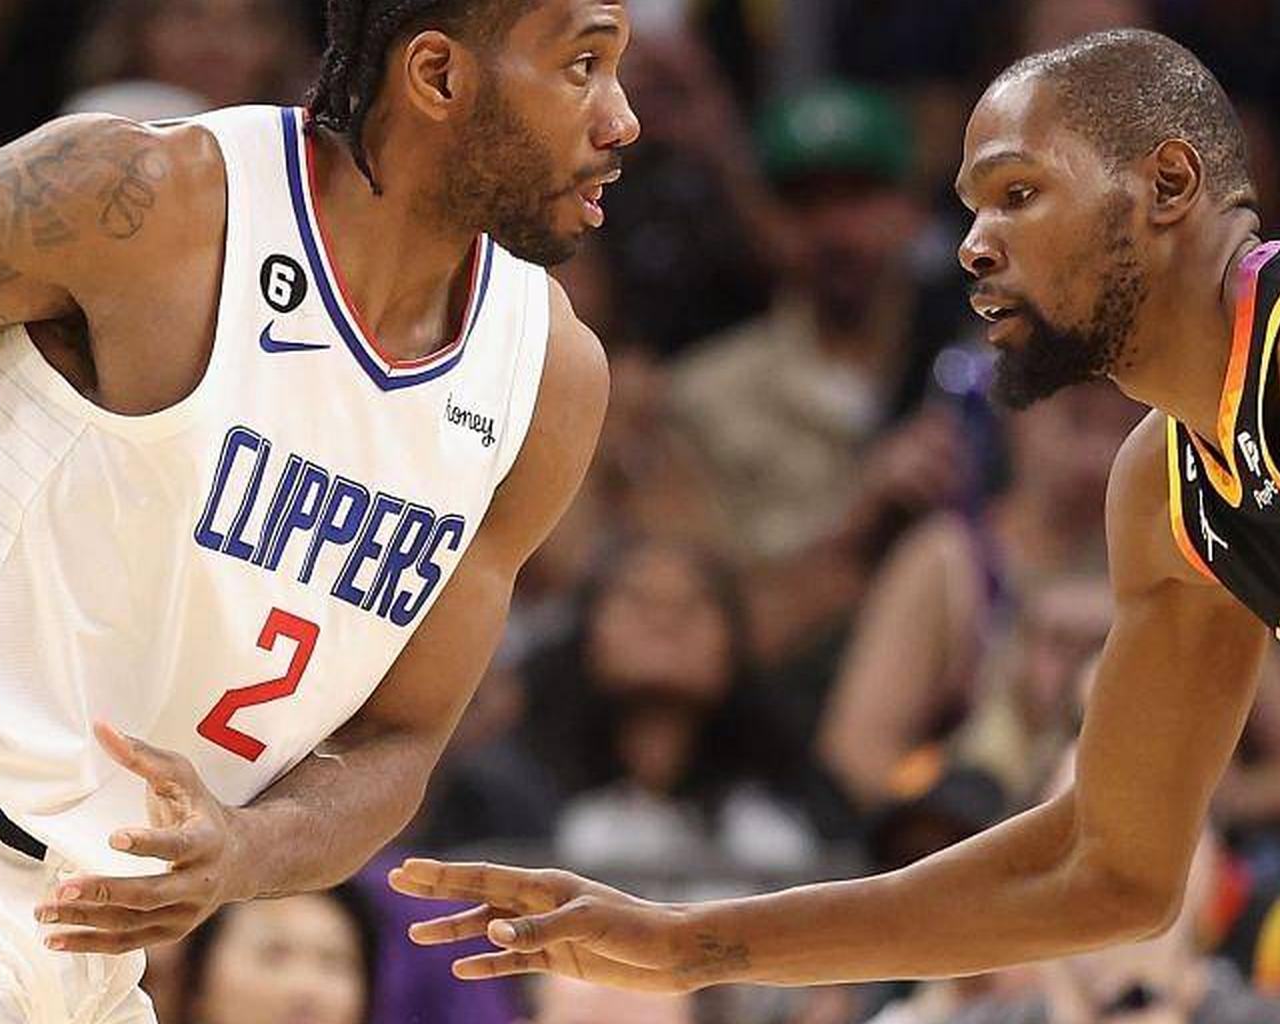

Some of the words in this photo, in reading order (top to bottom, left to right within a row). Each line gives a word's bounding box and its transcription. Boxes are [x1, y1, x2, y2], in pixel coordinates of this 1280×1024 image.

[266, 262, 296, 307] 6
[194, 425, 465, 627] CLIPPERS
[195, 606, 321, 762] 2
